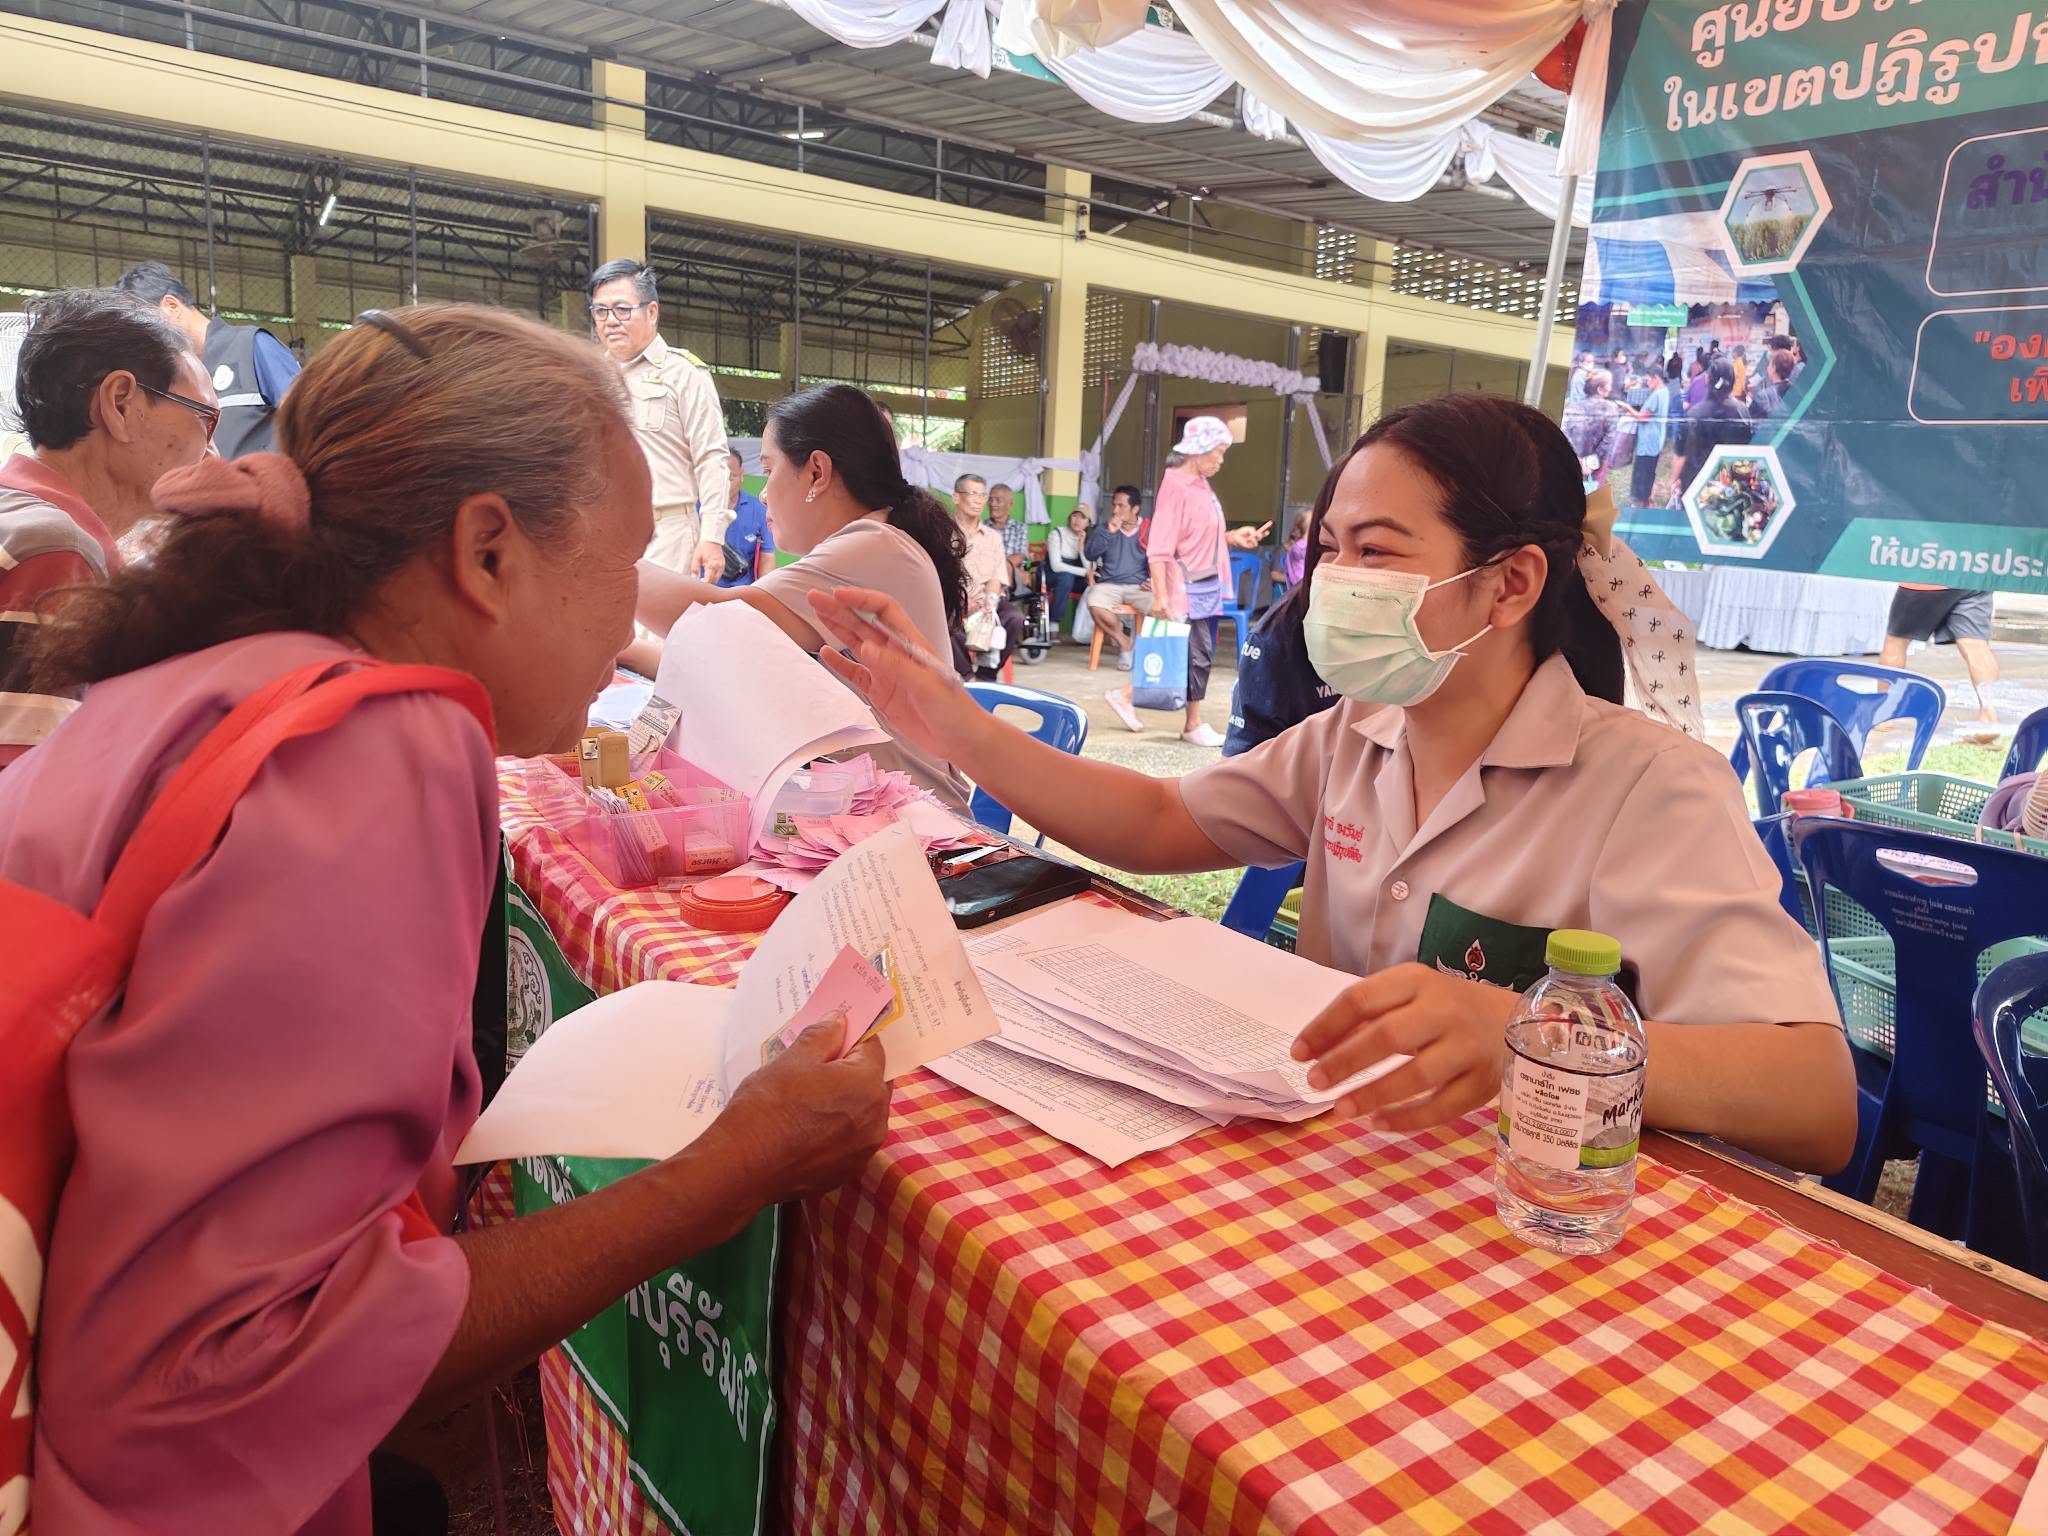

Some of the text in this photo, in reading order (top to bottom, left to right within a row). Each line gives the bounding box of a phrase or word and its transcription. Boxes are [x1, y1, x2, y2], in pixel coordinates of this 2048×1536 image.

[1975, 331, 2048, 360] "อง
[1869, 535, 2048, 578] ให้บริการประ
[1543, 1134, 1555, 1145] 350
